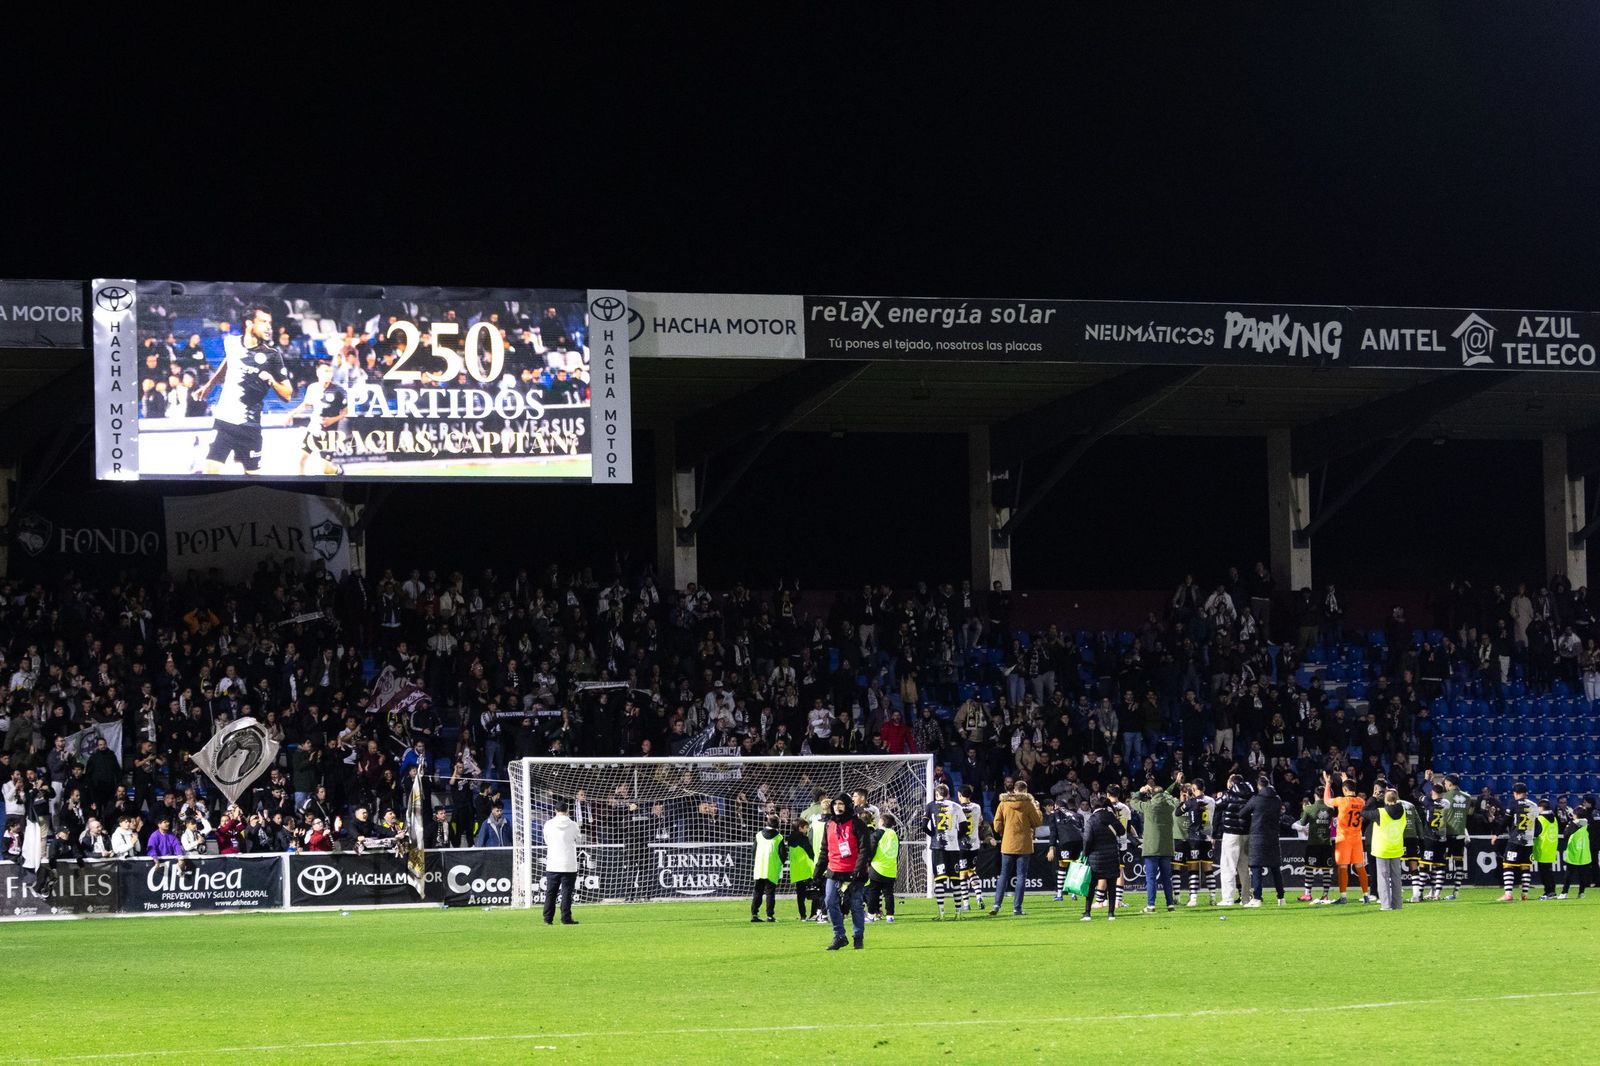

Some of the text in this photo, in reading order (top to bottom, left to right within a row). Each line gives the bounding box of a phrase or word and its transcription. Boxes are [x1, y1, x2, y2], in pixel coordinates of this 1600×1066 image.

[12, 305, 83, 322] MOTOR
[811, 300, 1057, 329] relaX energía solar
[653, 317, 797, 335] HACHA MOTOR
[1084, 311, 1343, 360] NEUMÁTICOS PARKING
[1517, 316, 1580, 339] AZUL
[829, 337, 1043, 353] Tú pones el tejado, nosotros las placas
[1360, 328, 1446, 351] AMTEL
[384, 321, 505, 383] 250
[1502, 343, 1596, 366] TELECO
[110, 321, 123, 474] HACHA MOTOR
[345, 384, 545, 420] PARTIDOS
[604, 330, 617, 478] HACHA MOTOR
[59, 527, 160, 555] FONDO
[174, 521, 309, 555] POPVLAR
[937, 813, 953, 831] 21
[1347, 810, 1361, 827] 13
[654, 850, 734, 868] TERNERA
[6, 873, 112, 899] FRILES
[346, 872, 442, 885] HACHA MOR
[659, 869, 732, 888] CHARRA
[1010, 877, 1043, 888] Gass
[162, 892, 207, 900] PREVENCION
[236, 890, 269, 898] LABORAL
